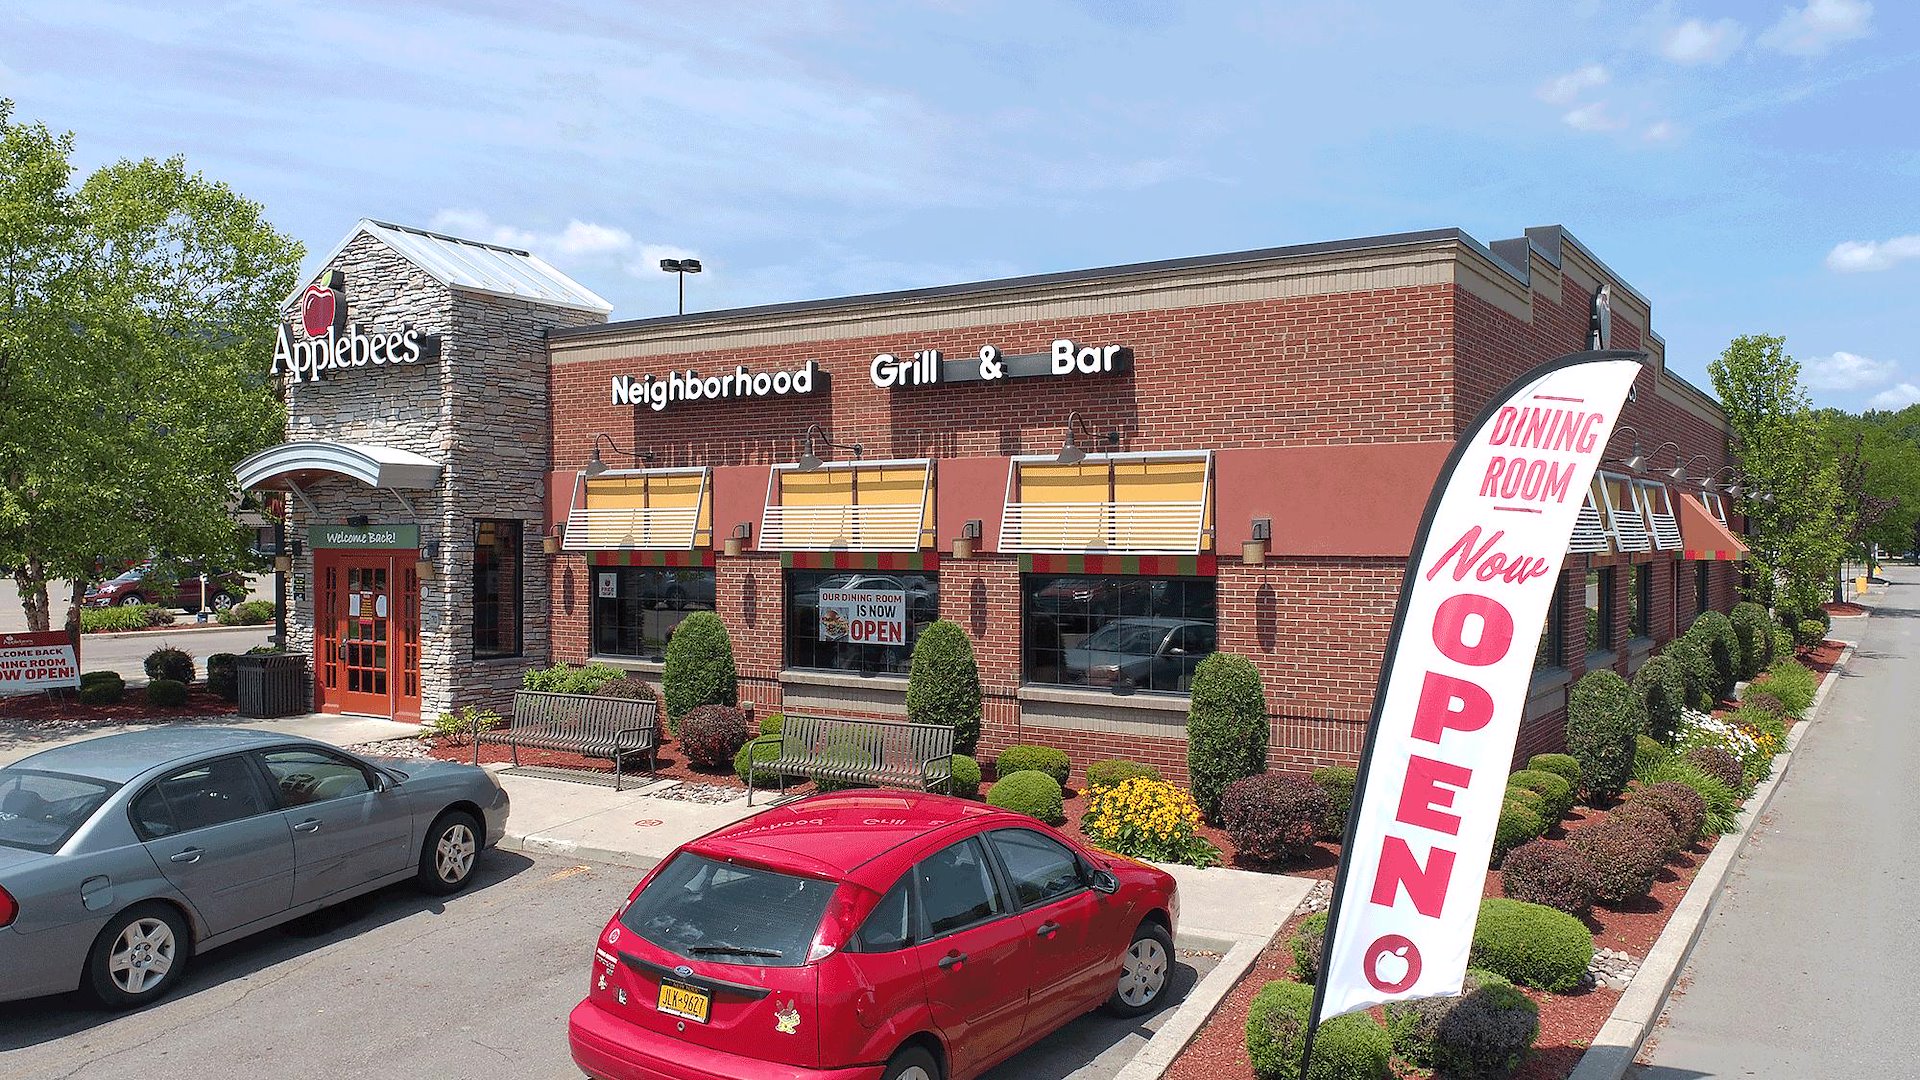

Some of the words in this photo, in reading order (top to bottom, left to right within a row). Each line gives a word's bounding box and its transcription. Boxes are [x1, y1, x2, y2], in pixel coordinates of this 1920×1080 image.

[270, 323, 420, 383] Applebee's
[870, 349, 938, 388] Grill
[979, 345, 1002, 380] &
[1052, 339, 1121, 375] Bar
[611, 360, 813, 411] Neighborhood
[1489, 406, 1604, 454] DINING
[1479, 456, 1577, 504] ROOM
[326, 531, 367, 544] Welcome
[368, 531, 396, 544] Back!
[1426, 525, 1550, 585] Now
[822, 593, 841, 601] OUR
[842, 593, 872, 602] DINING
[876, 595, 902, 603] ROOM
[856, 605, 867, 617] IS
[869, 605, 896, 618] NOW
[850, 620, 902, 642] OPEN
[25, 667, 75, 680] OPEN!
[30, 659, 66, 667] ROOM
[1370, 593, 1514, 919] OPEN
